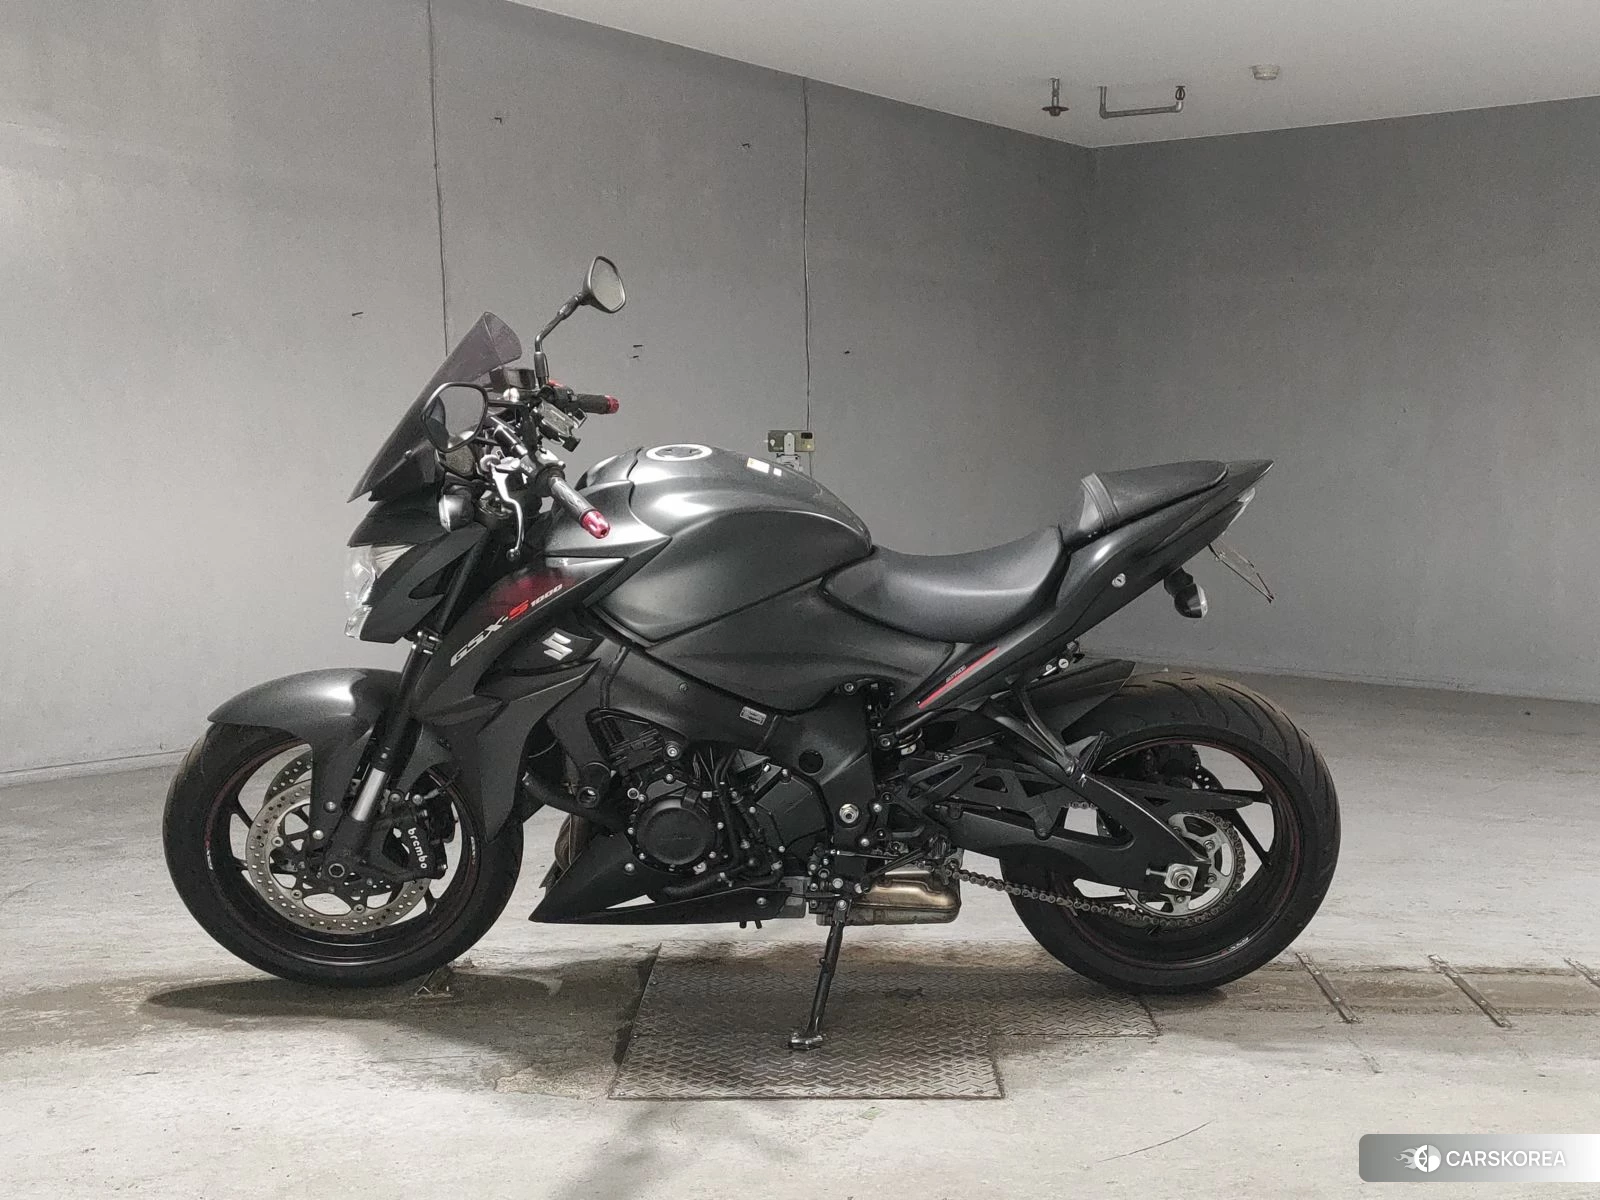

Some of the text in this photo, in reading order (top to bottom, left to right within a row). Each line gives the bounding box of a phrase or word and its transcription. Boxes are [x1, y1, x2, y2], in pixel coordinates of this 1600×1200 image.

[450, 583, 563, 667] GSX-S 1000
[407, 827, 428, 869] brembo
